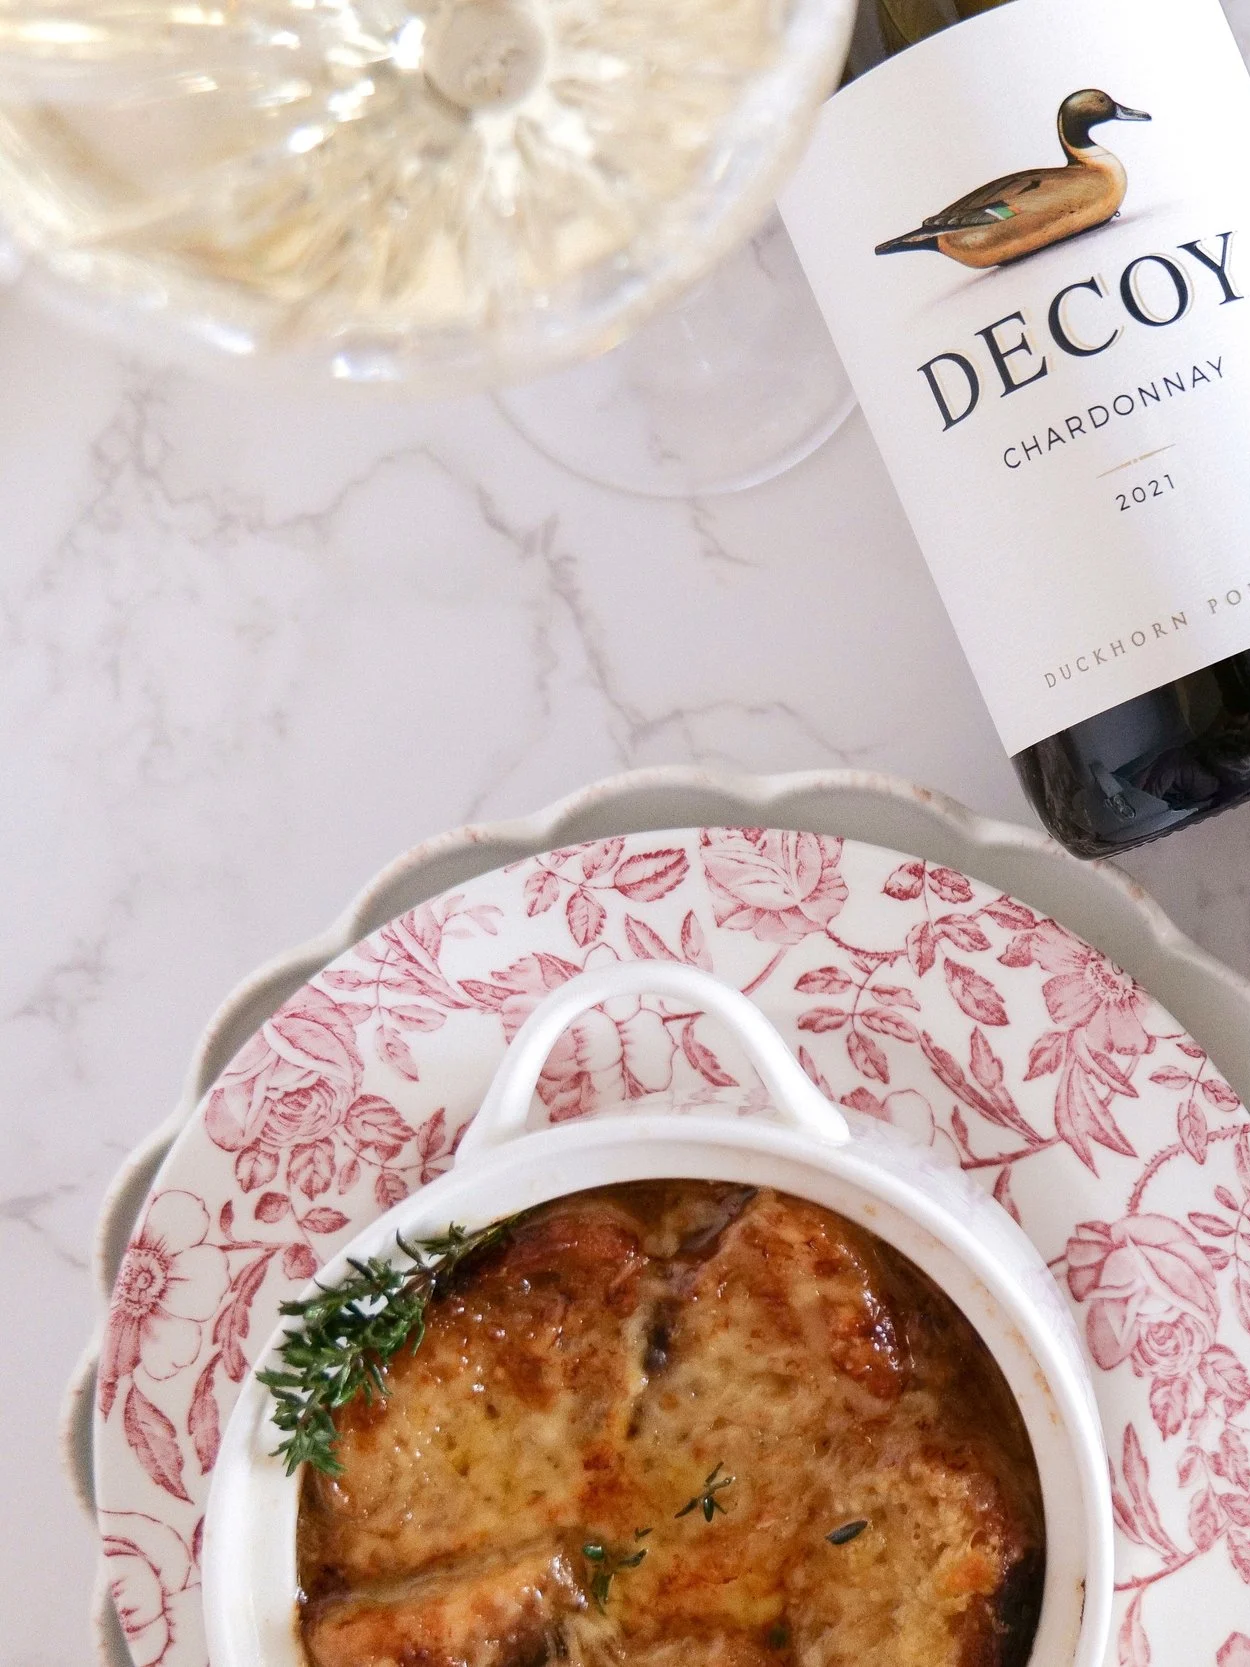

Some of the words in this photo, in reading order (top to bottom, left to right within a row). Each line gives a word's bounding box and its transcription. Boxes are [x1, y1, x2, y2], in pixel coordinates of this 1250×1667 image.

[917, 231, 1244, 432] DECOY
[1002, 356, 1226, 469] CHARDONNAY
[1115, 474, 1176, 511] 2021
[1044, 611, 1189, 688] DUCKHORN
